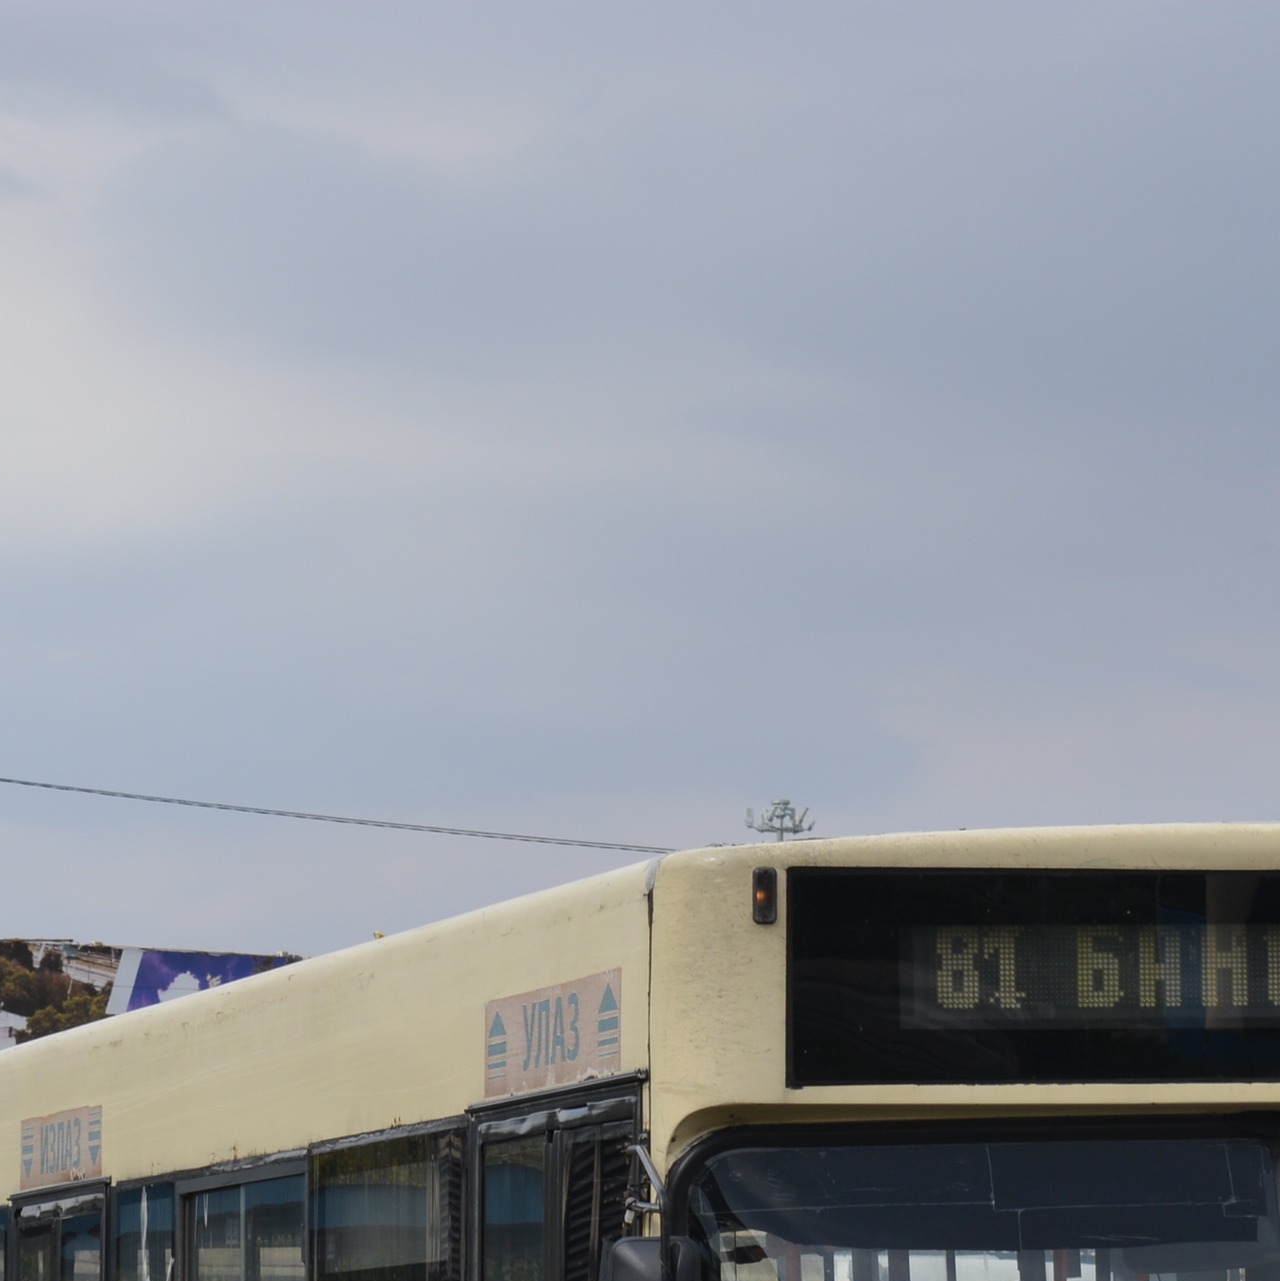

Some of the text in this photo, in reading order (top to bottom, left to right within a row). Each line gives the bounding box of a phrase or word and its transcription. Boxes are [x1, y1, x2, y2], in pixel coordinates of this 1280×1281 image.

[936, 924, 1026, 1009] 81
[522, 992, 581, 1072] УЛАЗ
[40, 1116, 82, 1175] ИЗЛАЗ
